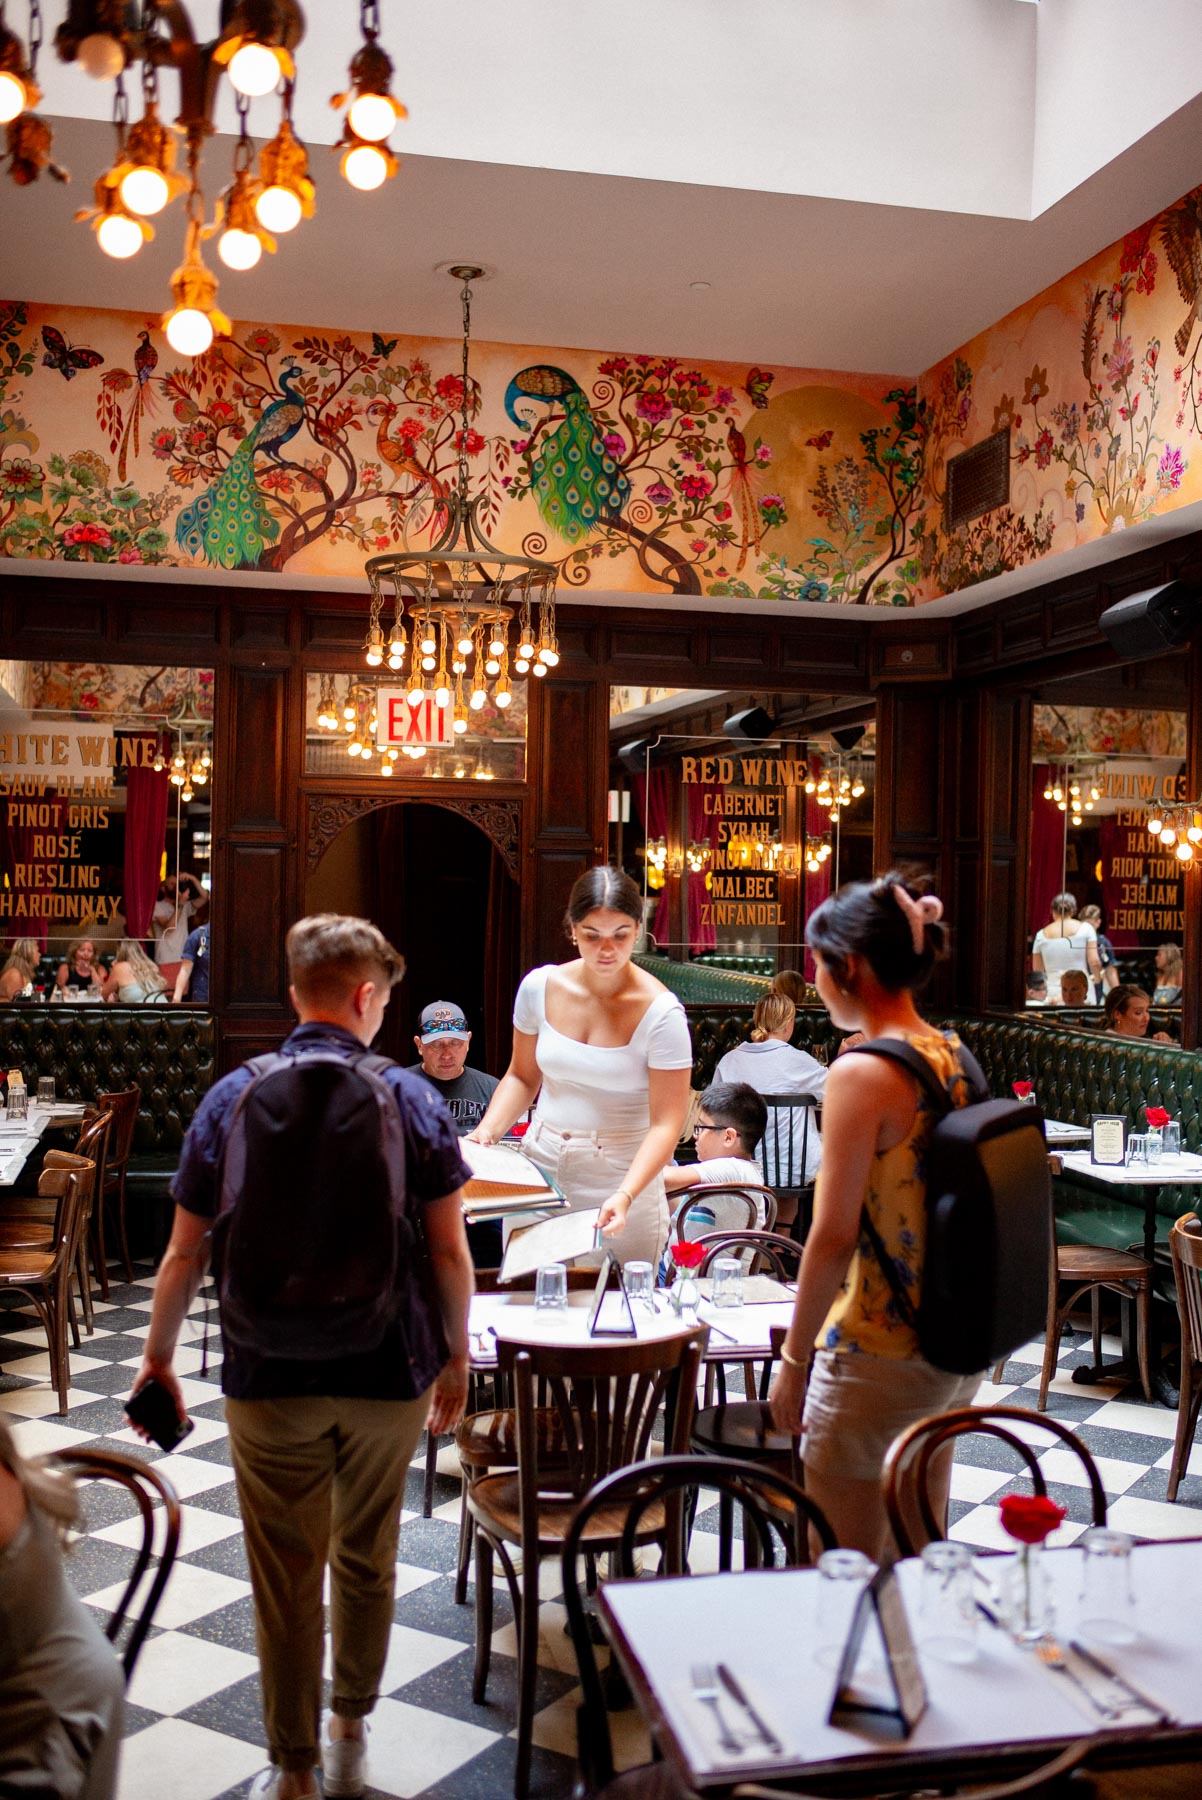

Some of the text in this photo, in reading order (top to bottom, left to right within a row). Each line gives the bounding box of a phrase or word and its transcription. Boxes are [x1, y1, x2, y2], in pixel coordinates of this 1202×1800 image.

[388, 698, 444, 742] EXIT
[0, 733, 157, 768] HITE WINE
[681, 756, 808, 787] RED WINE
[0, 773, 116, 800] SAUV BLANC
[7, 803, 110, 829] PINOT GRIS
[703, 793, 785, 816] CABERNET
[33, 829, 82, 859] ROSÉ
[717, 821, 770, 844] SYRAH
[700, 849, 745, 872] PINOT
[14, 863, 101, 889] RIESLING
[711, 876, 775, 899] MALBEC
[0, 894, 123, 919] HARDONNAY
[700, 903, 786, 926] ZINFANDEL
